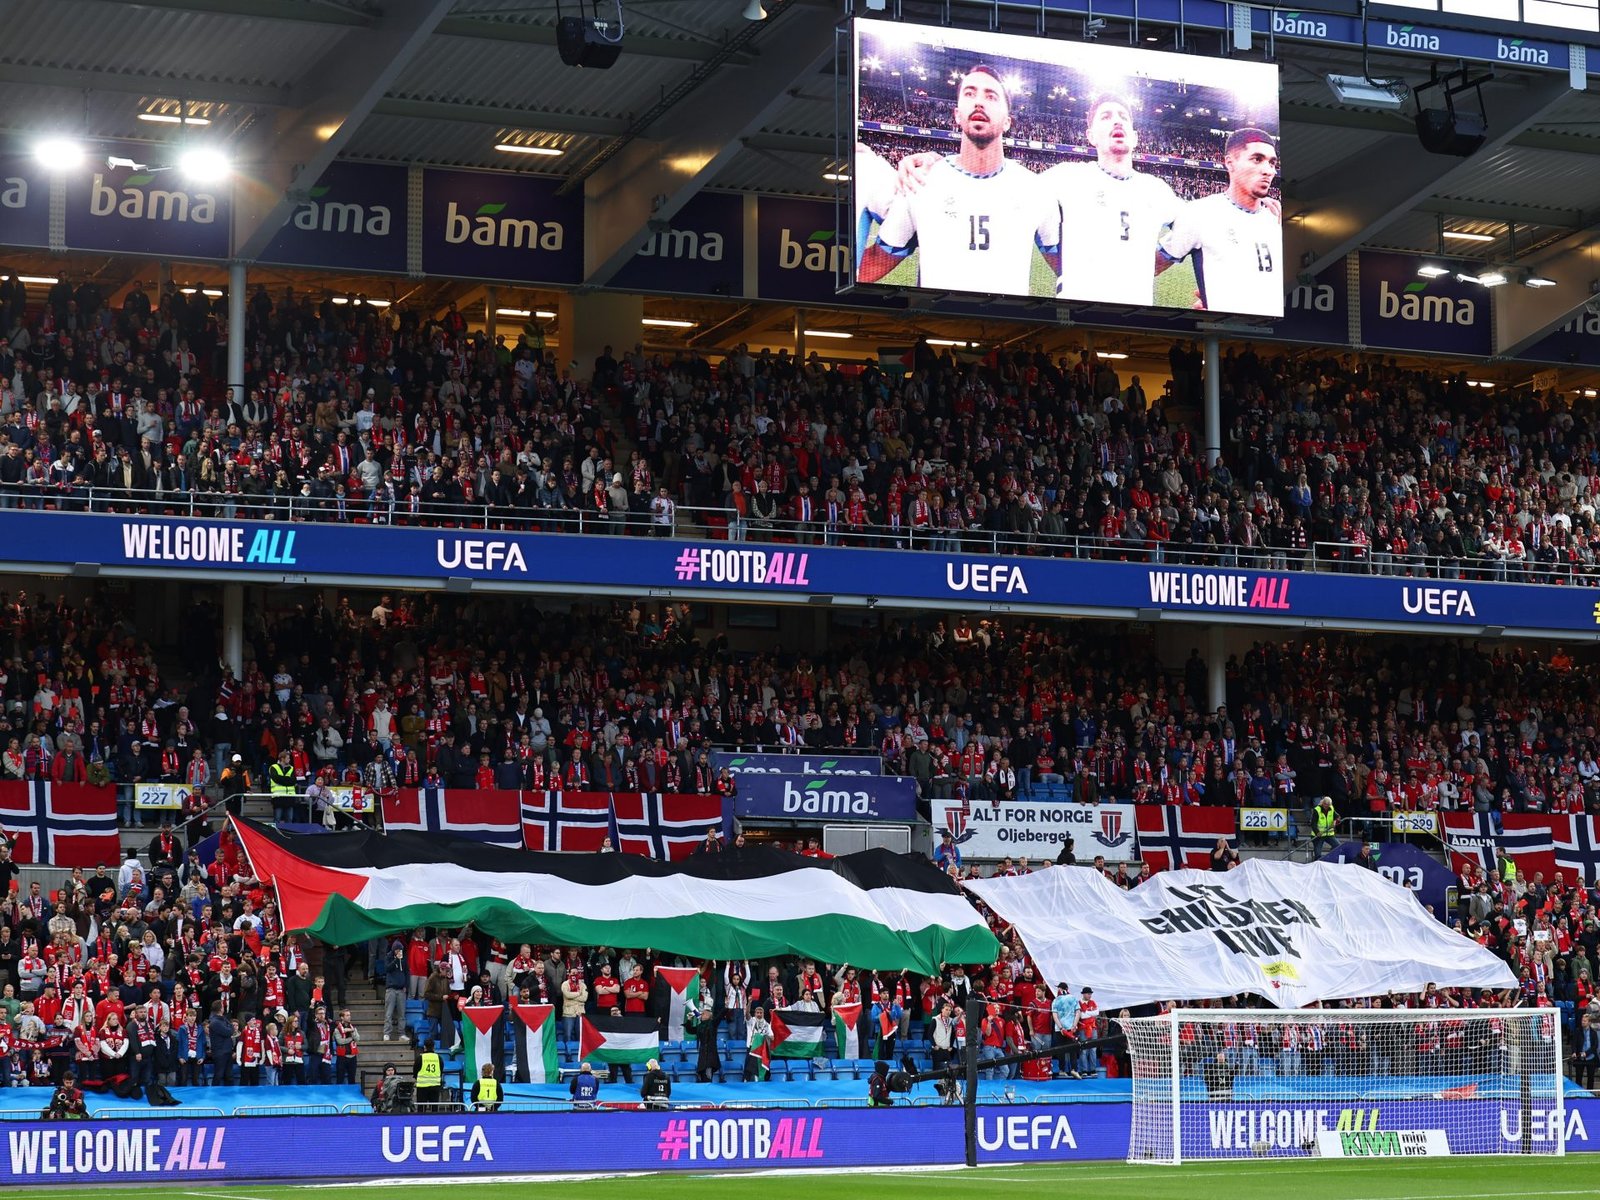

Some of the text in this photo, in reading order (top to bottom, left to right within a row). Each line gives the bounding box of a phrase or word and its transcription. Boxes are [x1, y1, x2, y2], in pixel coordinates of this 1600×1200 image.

[1273, 12, 1327, 37] bama
[1387, 25, 1440, 50] bama
[1497, 39, 1549, 65] bama
[89, 173, 216, 224] bama
[283, 200, 391, 236] ama
[445, 202, 564, 251] bama
[968, 215, 991, 251] 15
[1120, 211, 1130, 241] 5
[1255, 243, 1273, 273] 13
[1379, 280, 1475, 325] bama
[122, 523, 297, 564] WELCOME ALL
[437, 539, 527, 572] UEFA
[674, 548, 809, 586] #FOOTBALL
[946, 562, 1029, 594] UEFA
[1149, 572, 1290, 609] WELCOME ALL
[1402, 587, 1476, 617] UEFA
[142, 792, 168, 805] 227
[783, 781, 869, 814] bama
[973, 808, 1093, 823] ALT FOR NORGE
[1245, 816, 1267, 827] 226
[1412, 819, 1433, 830] 229
[997, 828, 1072, 844] Oljeberget
[425, 1064, 436, 1073] 43
[486, 1089, 490, 1098] 1
[657, 1117, 824, 1160] #FOOTBALL
[977, 1115, 1077, 1151] UEFA
[1402, 1131, 1427, 1144] mini
[1501, 1109, 1589, 1142] UEFA
[8, 1127, 226, 1175] WELCOME ALL
[381, 1125, 494, 1163] UEFA
[1340, 1131, 1402, 1156] KIWI
